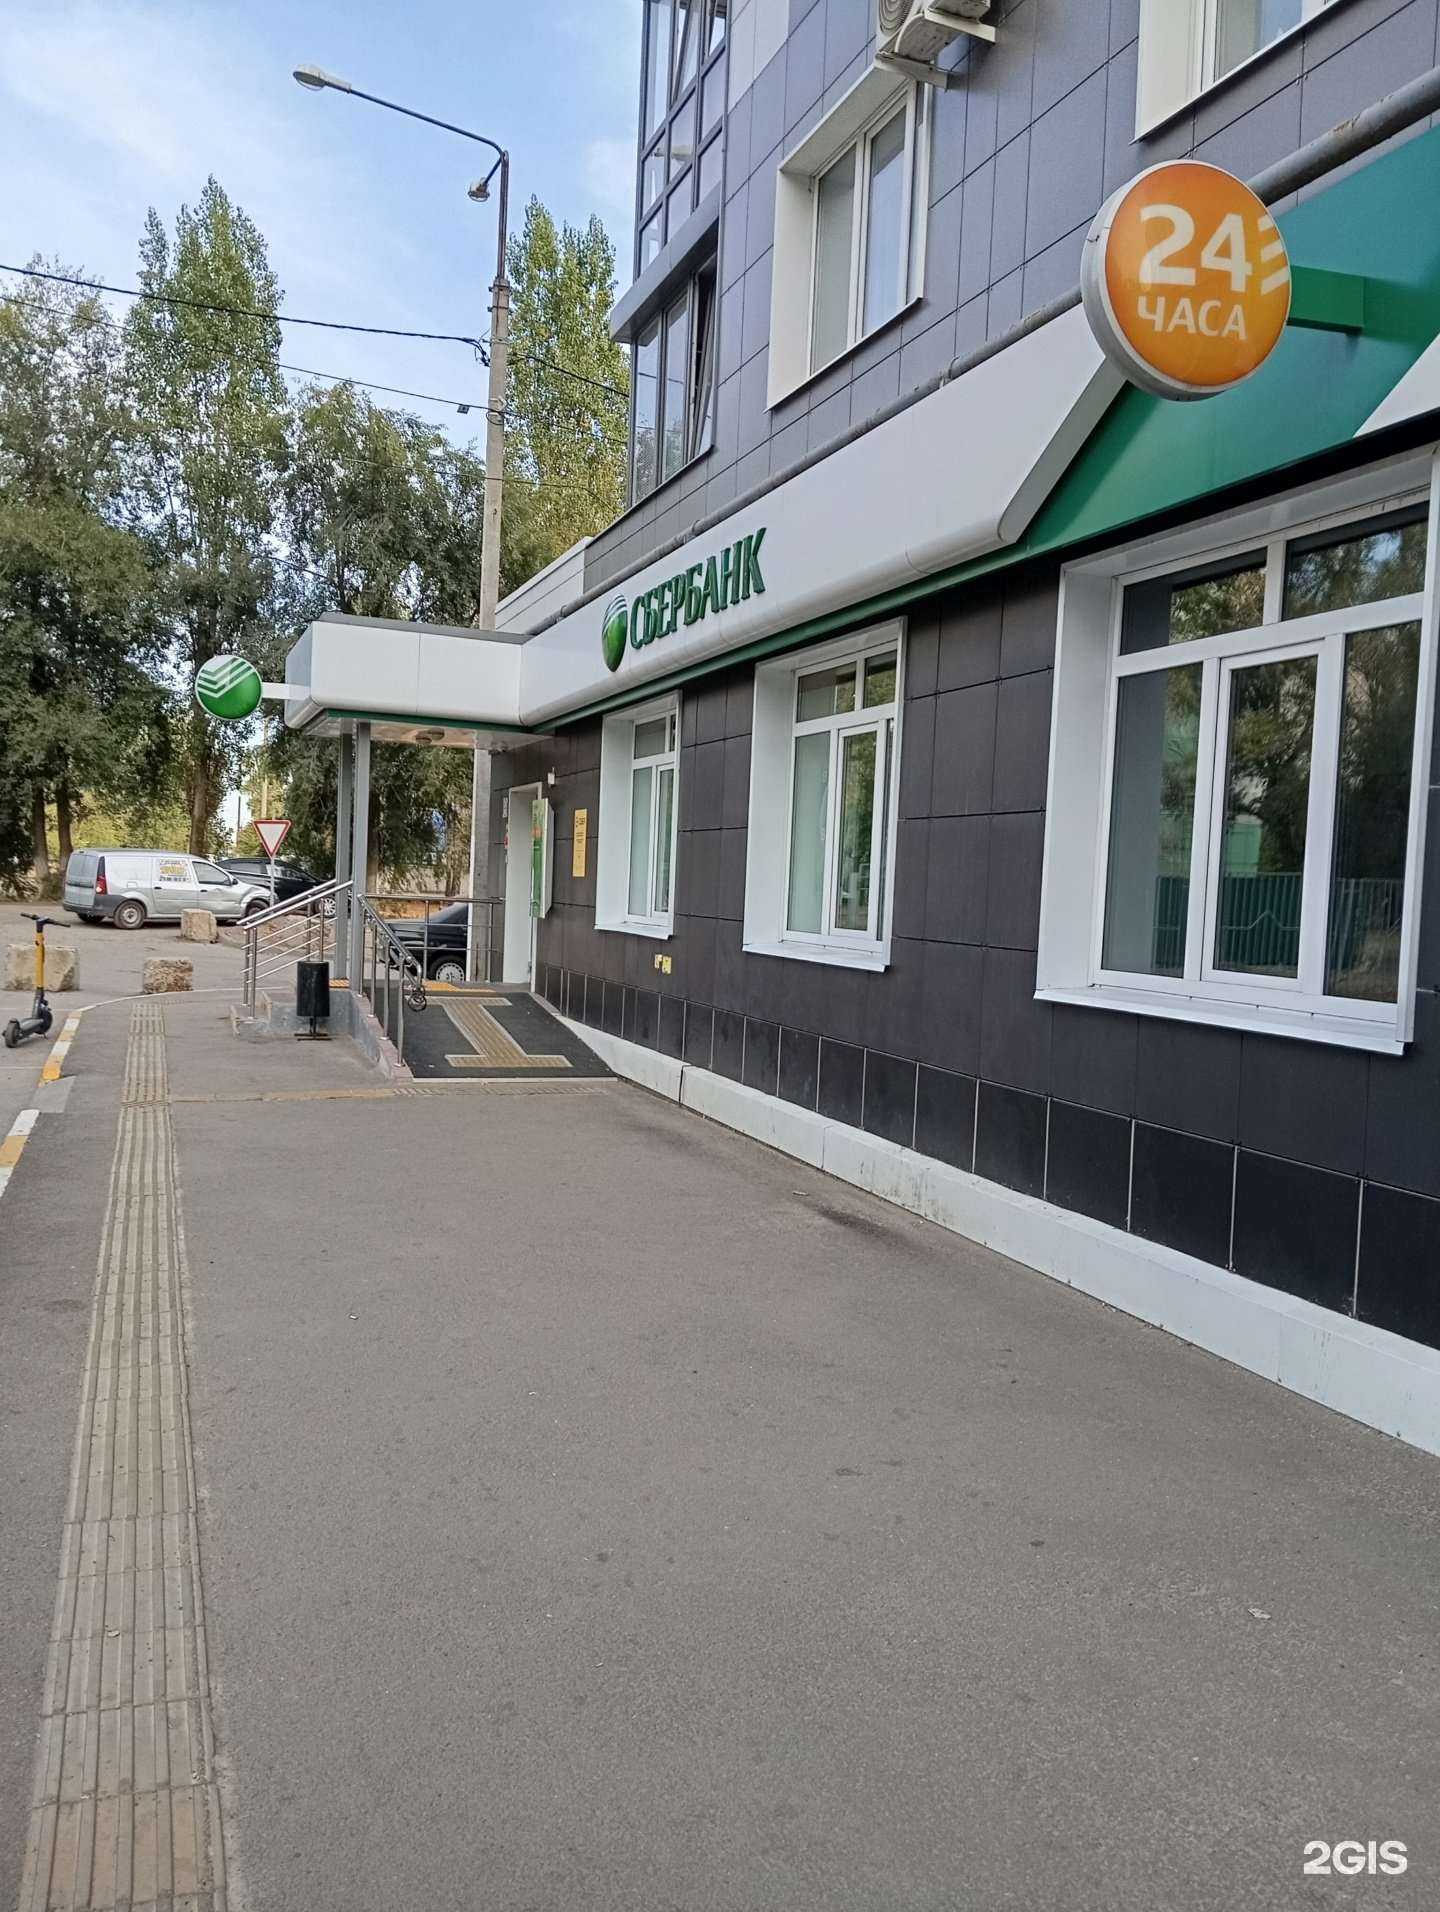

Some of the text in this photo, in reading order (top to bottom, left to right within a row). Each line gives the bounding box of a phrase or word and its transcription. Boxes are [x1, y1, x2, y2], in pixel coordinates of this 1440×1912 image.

[1139, 203, 1253, 293] 24
[1136, 295, 1247, 340] ЧАСА
[630, 527, 767, 650] СБЕРБАНК
